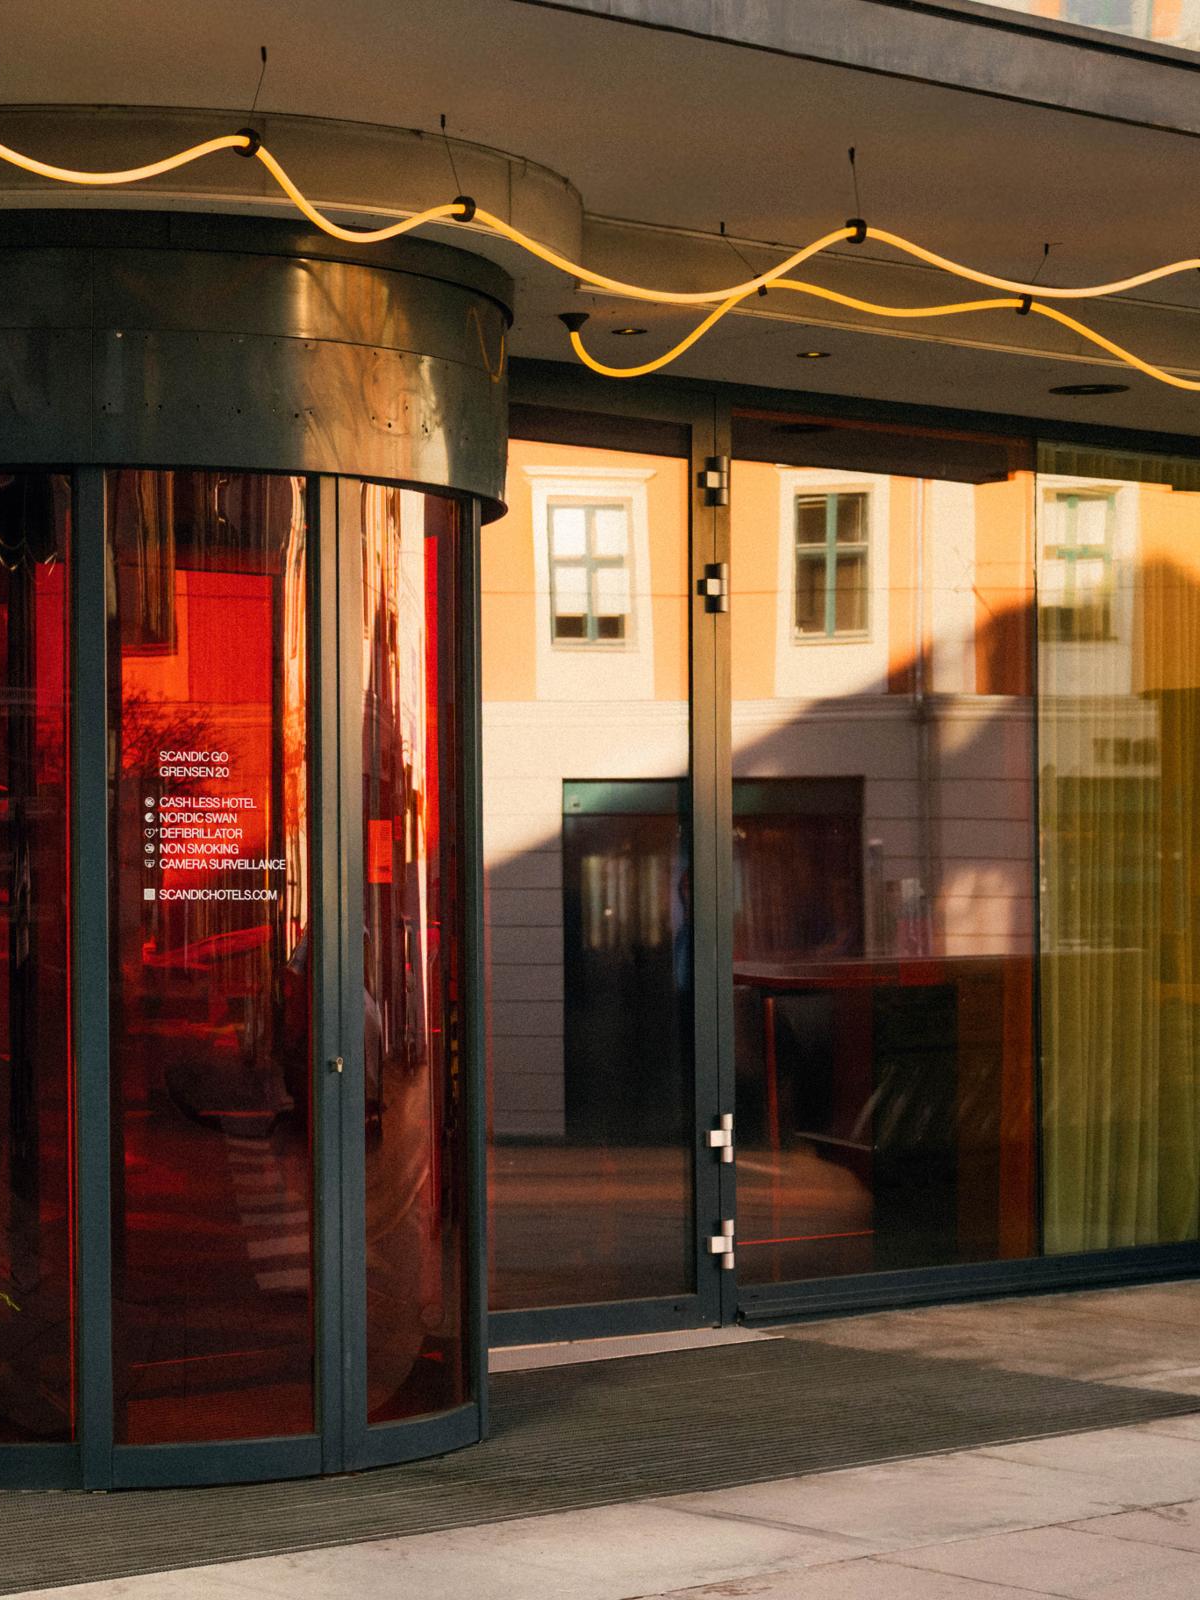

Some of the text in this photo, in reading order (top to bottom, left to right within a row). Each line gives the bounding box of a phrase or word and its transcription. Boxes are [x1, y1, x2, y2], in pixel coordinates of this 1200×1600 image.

[159, 751, 229, 763] SCANDIC GO
[159, 766, 230, 778] GRENSEN 20
[221, 797, 257, 809] HOTEL
[159, 812, 237, 823] NORDIC SWAN
[159, 827, 243, 839] DEFIBRILLATOR
[159, 843, 239, 855] NON SMOKING
[159, 859, 286, 870] CAMERA SURVEILLANCE
[158, 889, 278, 900] SCANDICHOTELS.COM
